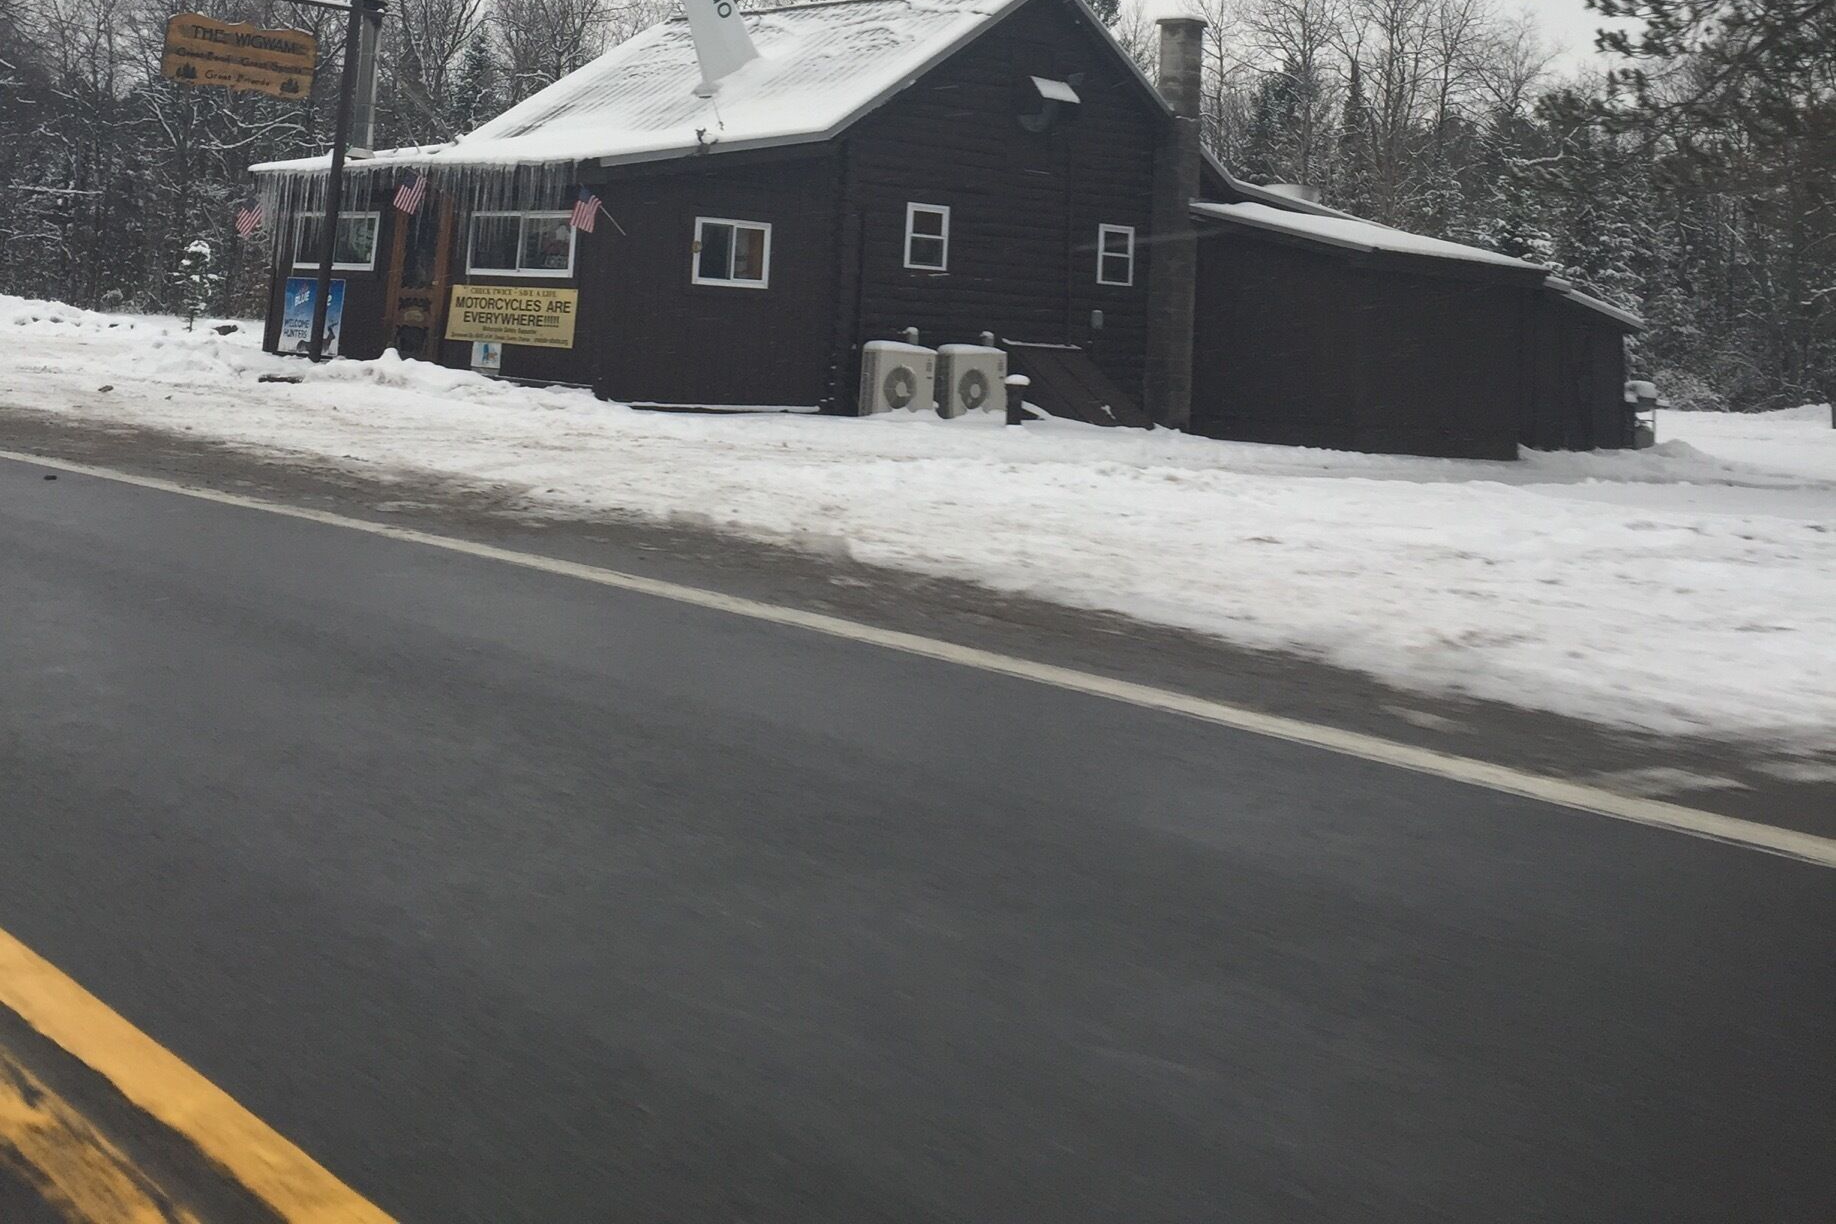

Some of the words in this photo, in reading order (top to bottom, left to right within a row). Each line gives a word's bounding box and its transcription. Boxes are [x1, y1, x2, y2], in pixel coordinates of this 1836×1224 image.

[192, 25, 225, 43] THE
[235, 31, 297, 54] WIGWAM
[204, 69, 232, 80] Great
[455, 296, 541, 313] MOTORCYCLES
[546, 301, 571, 314] ARE
[285, 318, 310, 329] WELCOME
[283, 329, 308, 339] HUNTERS
